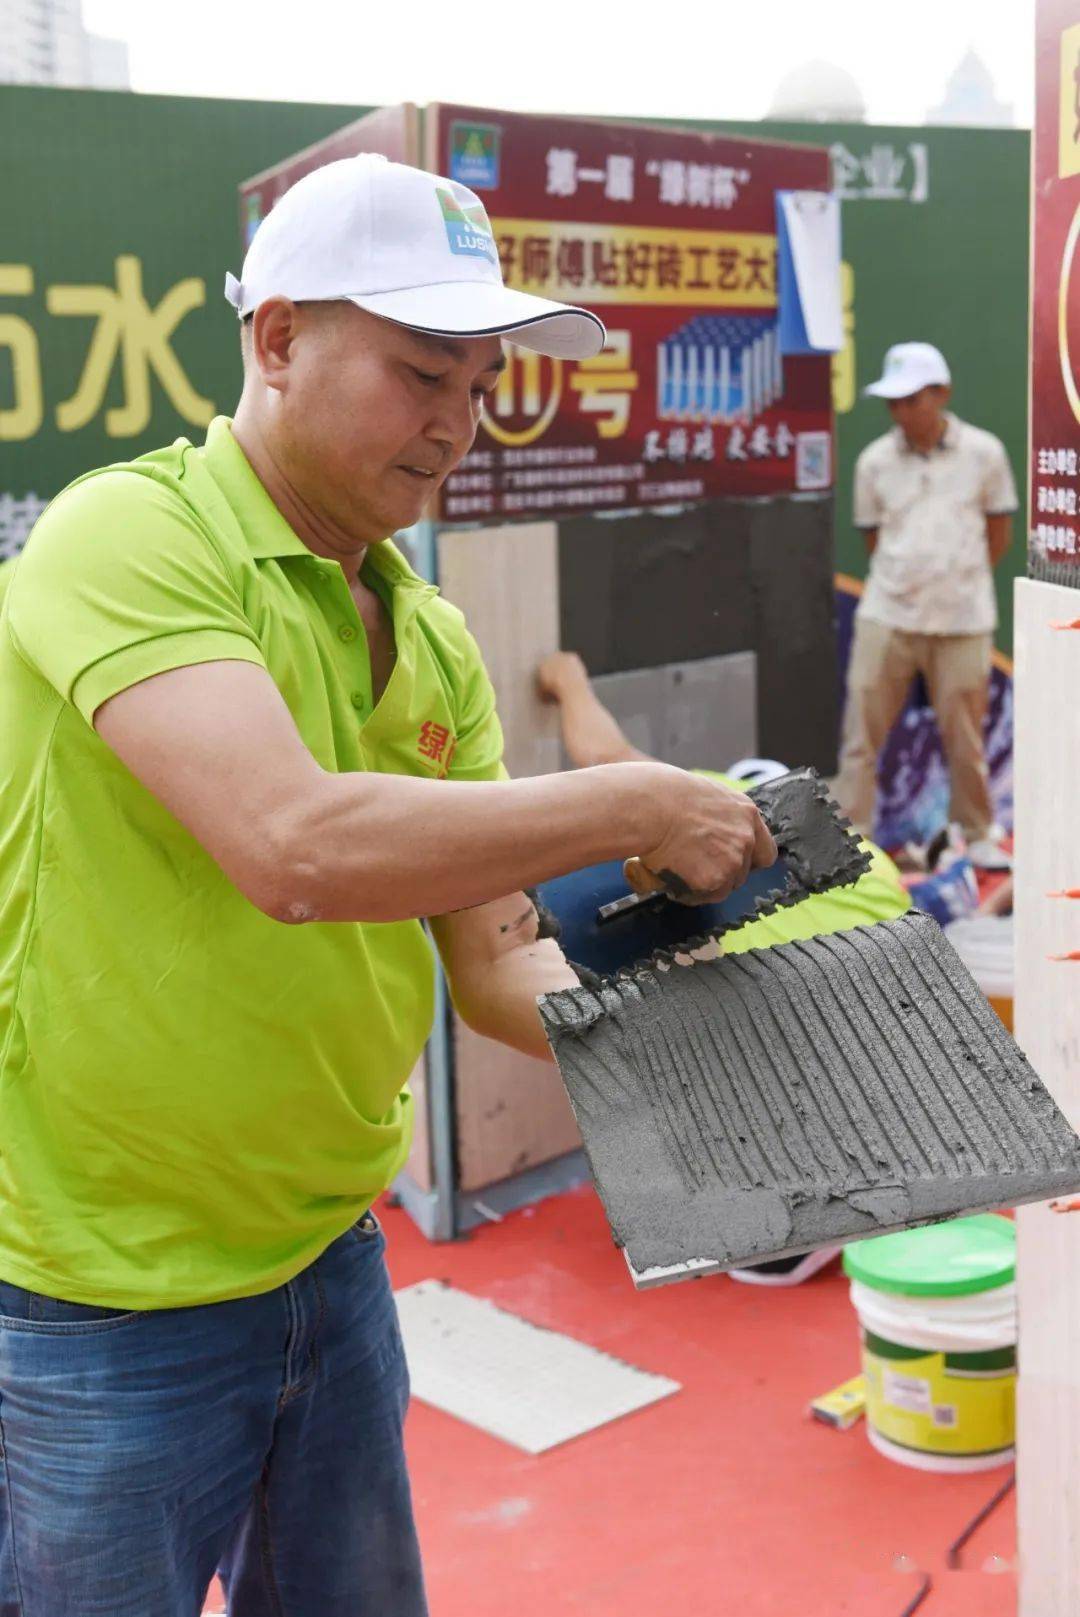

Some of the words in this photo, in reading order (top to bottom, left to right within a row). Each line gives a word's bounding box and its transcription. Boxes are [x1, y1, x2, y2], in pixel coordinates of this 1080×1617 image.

[499, 234, 778, 291] 好师傅贴好砖工艺大
